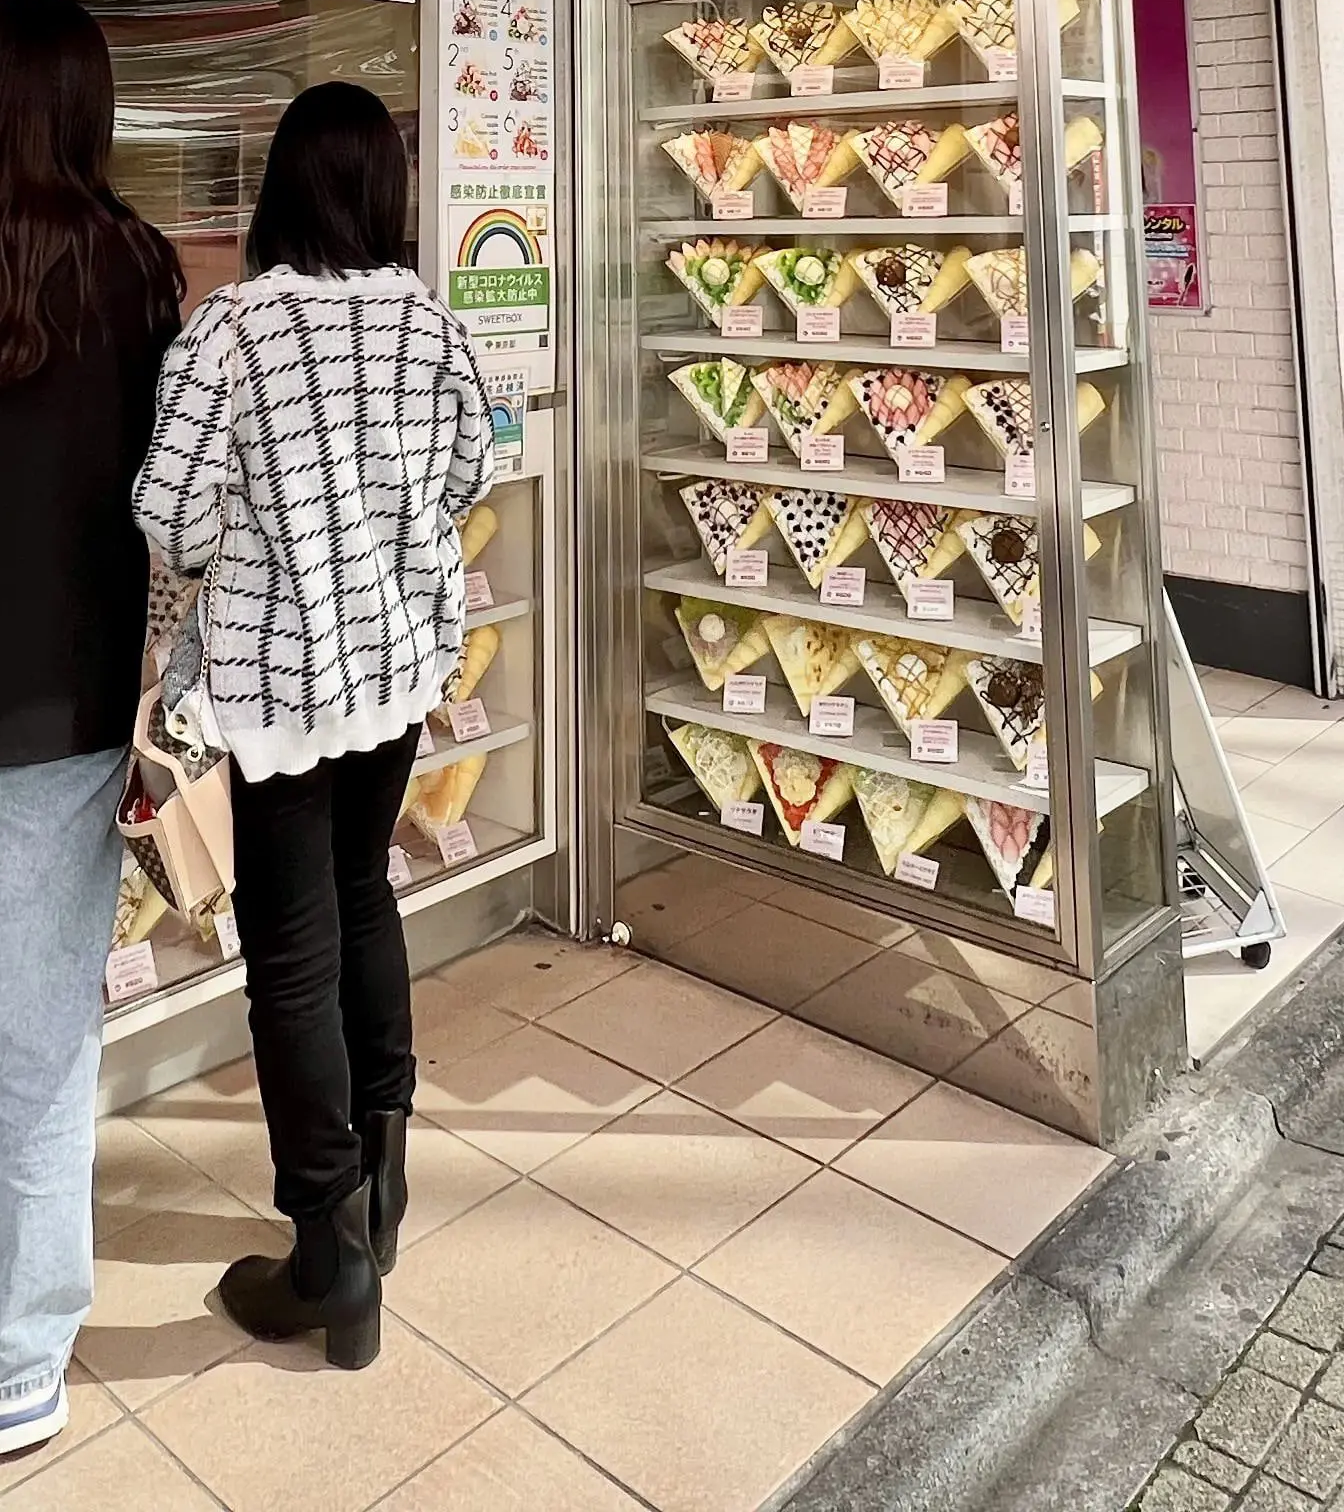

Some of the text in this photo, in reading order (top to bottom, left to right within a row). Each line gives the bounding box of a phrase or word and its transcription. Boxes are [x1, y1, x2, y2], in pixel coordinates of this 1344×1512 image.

[450, 183, 547, 200] 感染防止徹底宣言
[456, 272, 543, 289] 新型コロナウイルス
[463, 289, 538, 304] 感染拡大防止中
[478, 313, 522, 325] SWEETBOX
